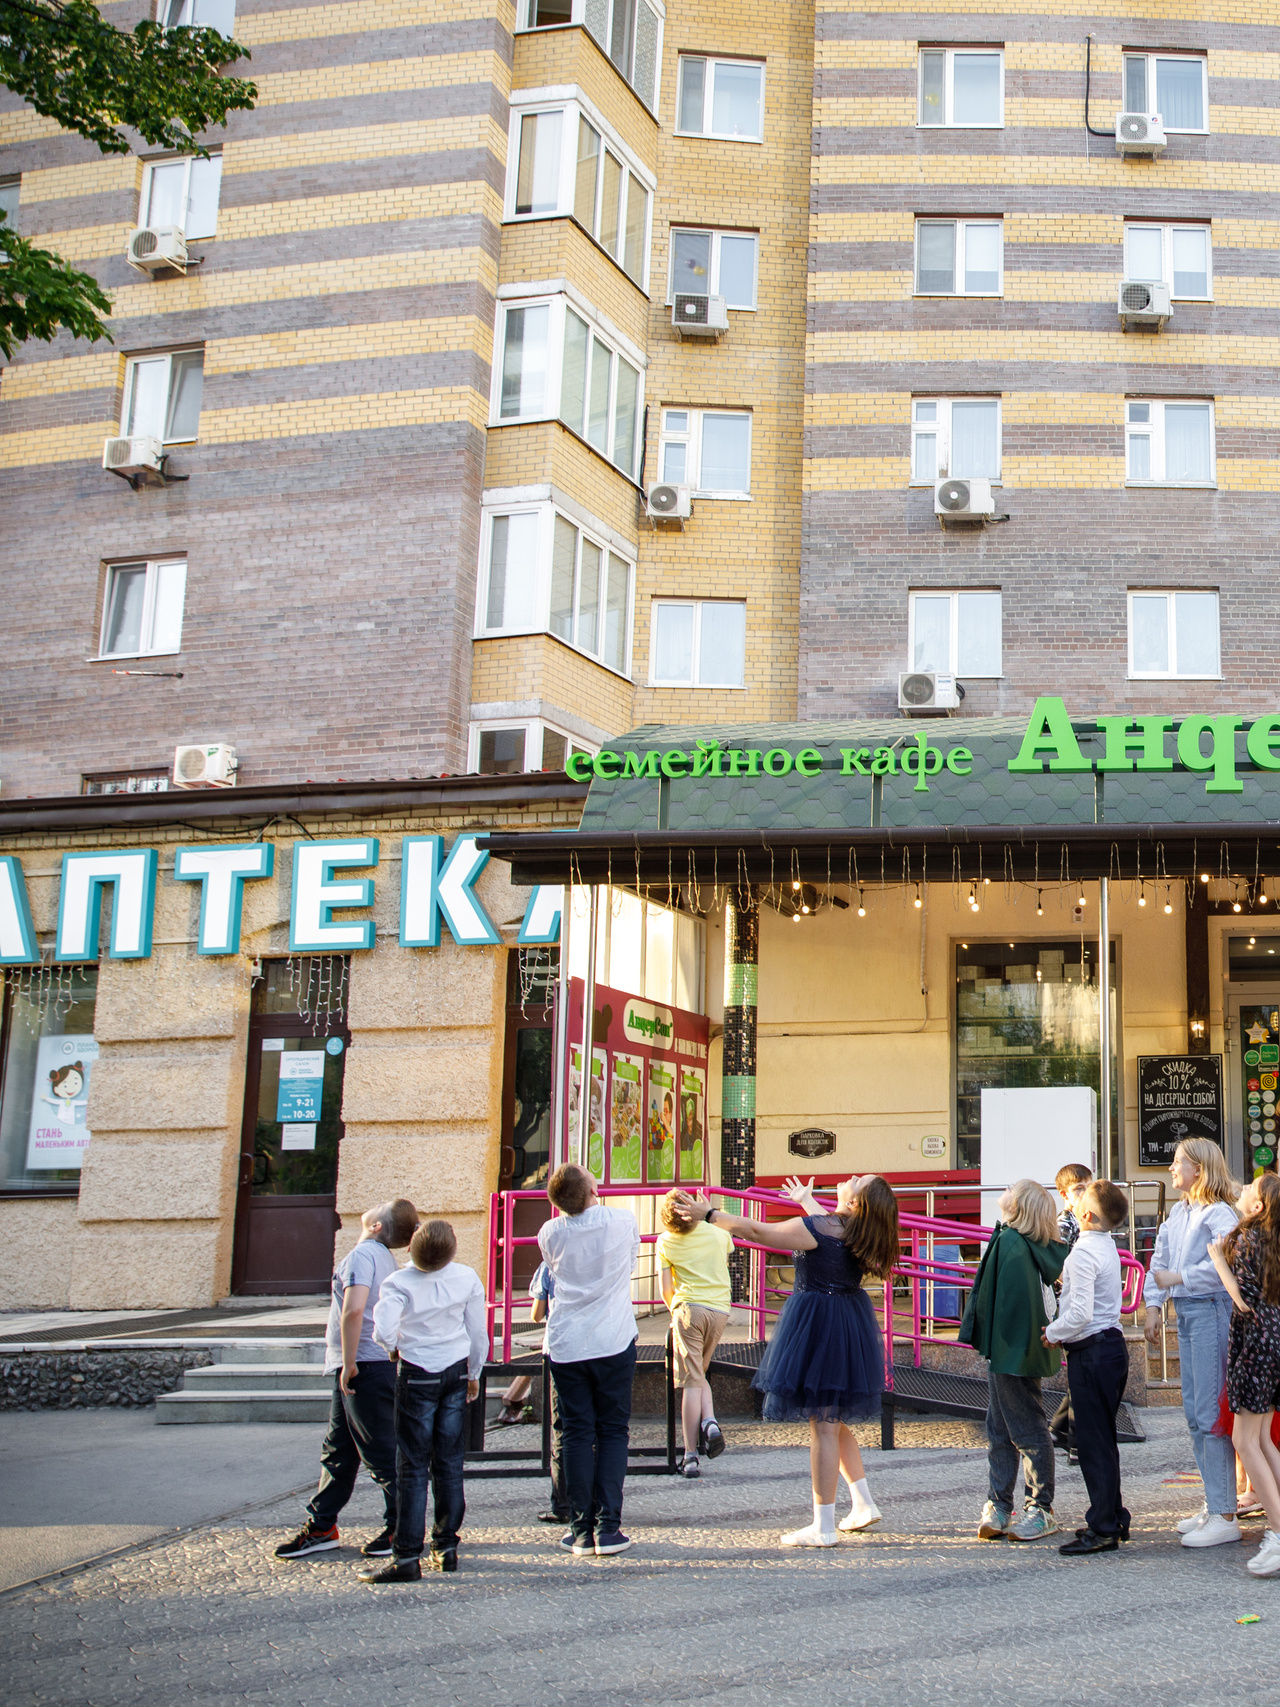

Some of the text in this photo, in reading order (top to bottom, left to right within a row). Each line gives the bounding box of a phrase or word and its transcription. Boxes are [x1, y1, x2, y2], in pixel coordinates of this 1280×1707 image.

[565, 739, 823, 783] семейное
[840, 732, 973, 792] кафе
[1161, 1061, 1197, 1076] СКИДКА
[296, 1098, 314, 1107] 9-21
[1144, 1090, 1216, 1107] НА ДЕСЕРТЫ С СОБОЙ
[293, 1110, 315, 1119] 10-20
[36, 1128, 63, 1139] СТАНЬ
[35, 1140, 75, 1149] МАЛЕНЬКИМ
[1147, 1142, 1159, 1152] ТРИ
